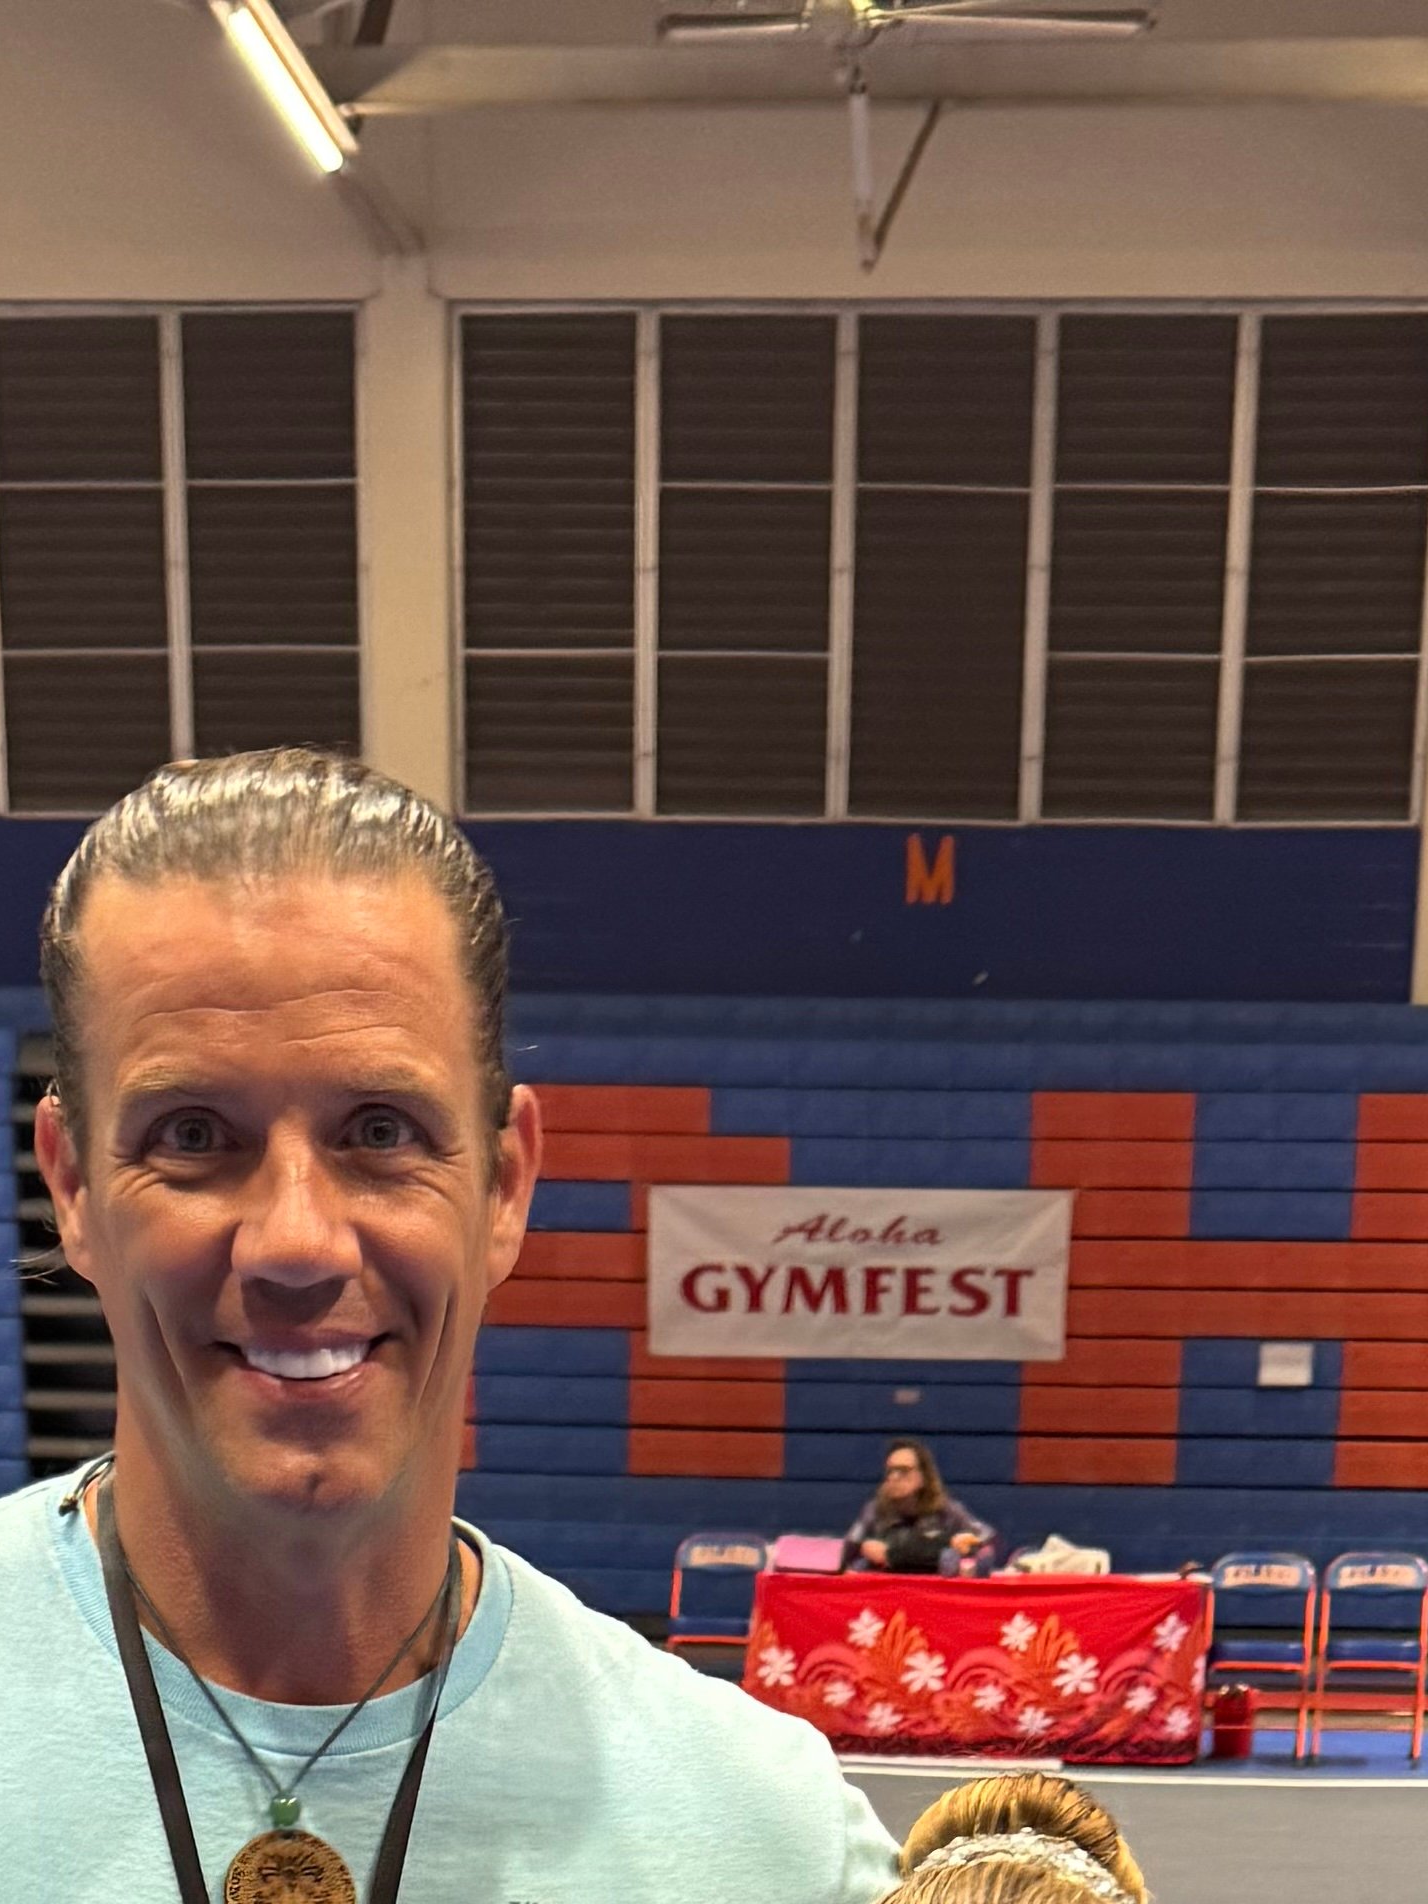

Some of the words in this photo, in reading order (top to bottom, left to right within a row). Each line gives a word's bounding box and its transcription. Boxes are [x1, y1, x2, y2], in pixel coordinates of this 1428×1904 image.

[905, 834, 955, 905] M
[772, 1213, 944, 1246] Aloha
[678, 1264, 1035, 1318] GYMFEST
